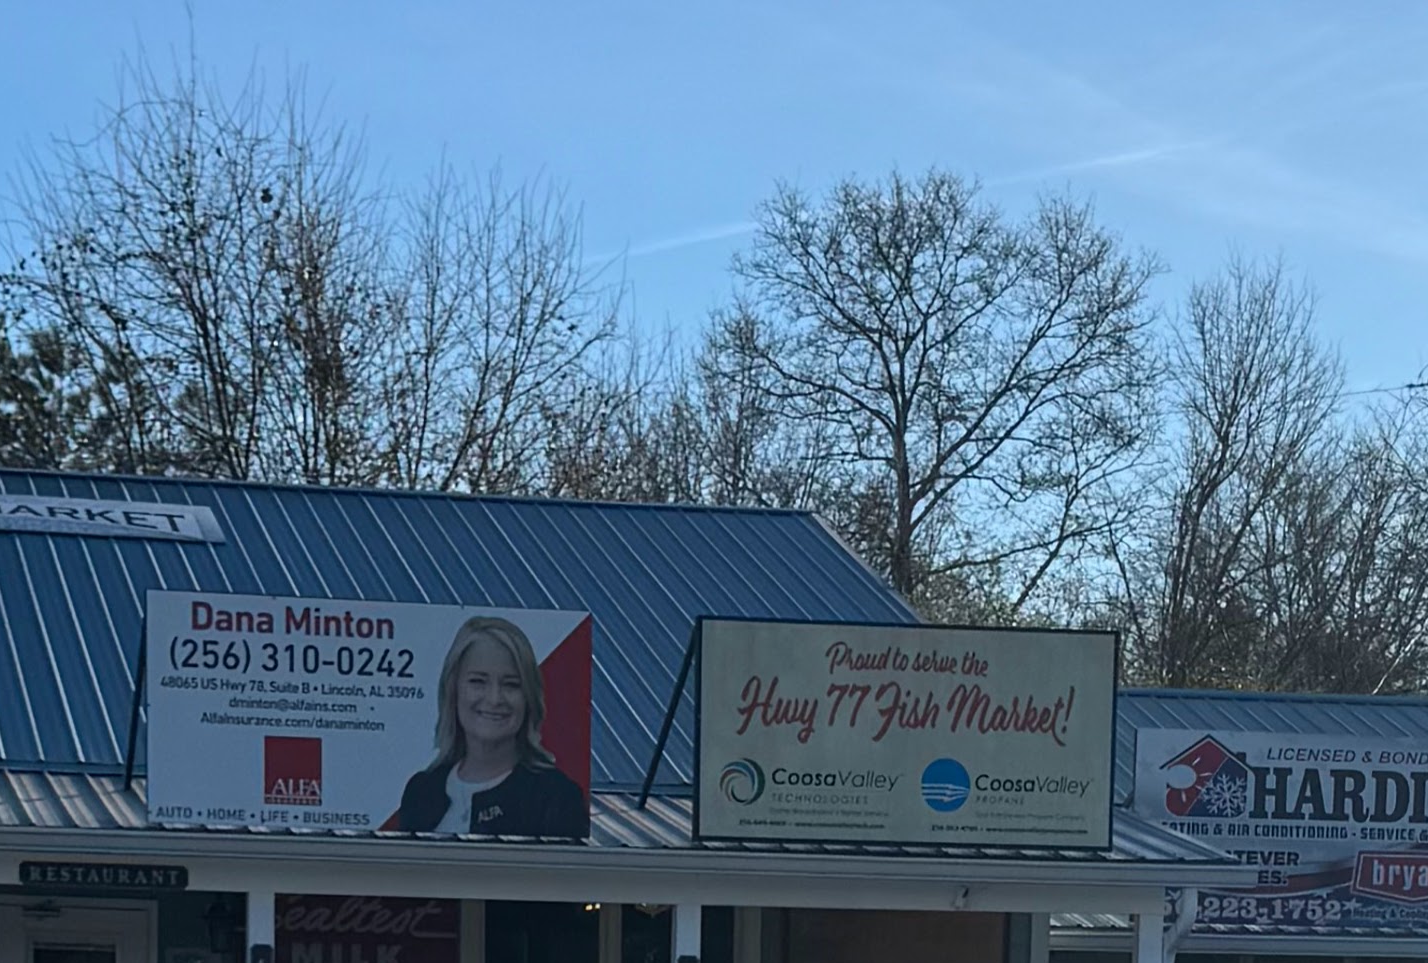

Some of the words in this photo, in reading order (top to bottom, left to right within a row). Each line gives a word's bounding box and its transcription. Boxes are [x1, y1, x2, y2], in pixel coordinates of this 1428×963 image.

[192, 601, 274, 633] Dana
[285, 606, 394, 639] Minton
[170, 636, 251, 674] (256)
[262, 642, 414, 679] 310-0242
[825, 641, 889, 675] Proud
[893, 647, 909, 671] to
[912, 654, 958, 677] serve
[961, 647, 988, 677] the
[200, 678, 218, 692] US
[220, 679, 246, 695] Hwy
[269, 681, 299, 695] Suite
[321, 684, 368, 698] Lincoln,
[370, 685, 386, 698] AL
[388, 686, 424, 700] 35096
[737, 675, 818, 744] Hwy
[827, 683, 870, 728] 77
[873, 681, 937, 742] Fish
[946, 684, 1076, 746] Market!
[1267, 747, 1356, 763] LICENSED
[1362, 751, 1372, 763] &
[272, 779, 320, 796] ALFA
[772, 794, 868, 806] TECHNOLOGIES
[975, 796, 1024, 807] PROPANE
[157, 806, 192, 821] AUTO
[208, 808, 245, 822] HOME
[260, 810, 288, 824] LIFE
[303, 811, 370, 826] BUSINESS
[1228, 824, 1250, 837] AIR
[1255, 824, 1348, 839] CONDITIONING
[1361, 828, 1414, 841] SERVICE
[30, 865, 180, 885] RESTAURANT
